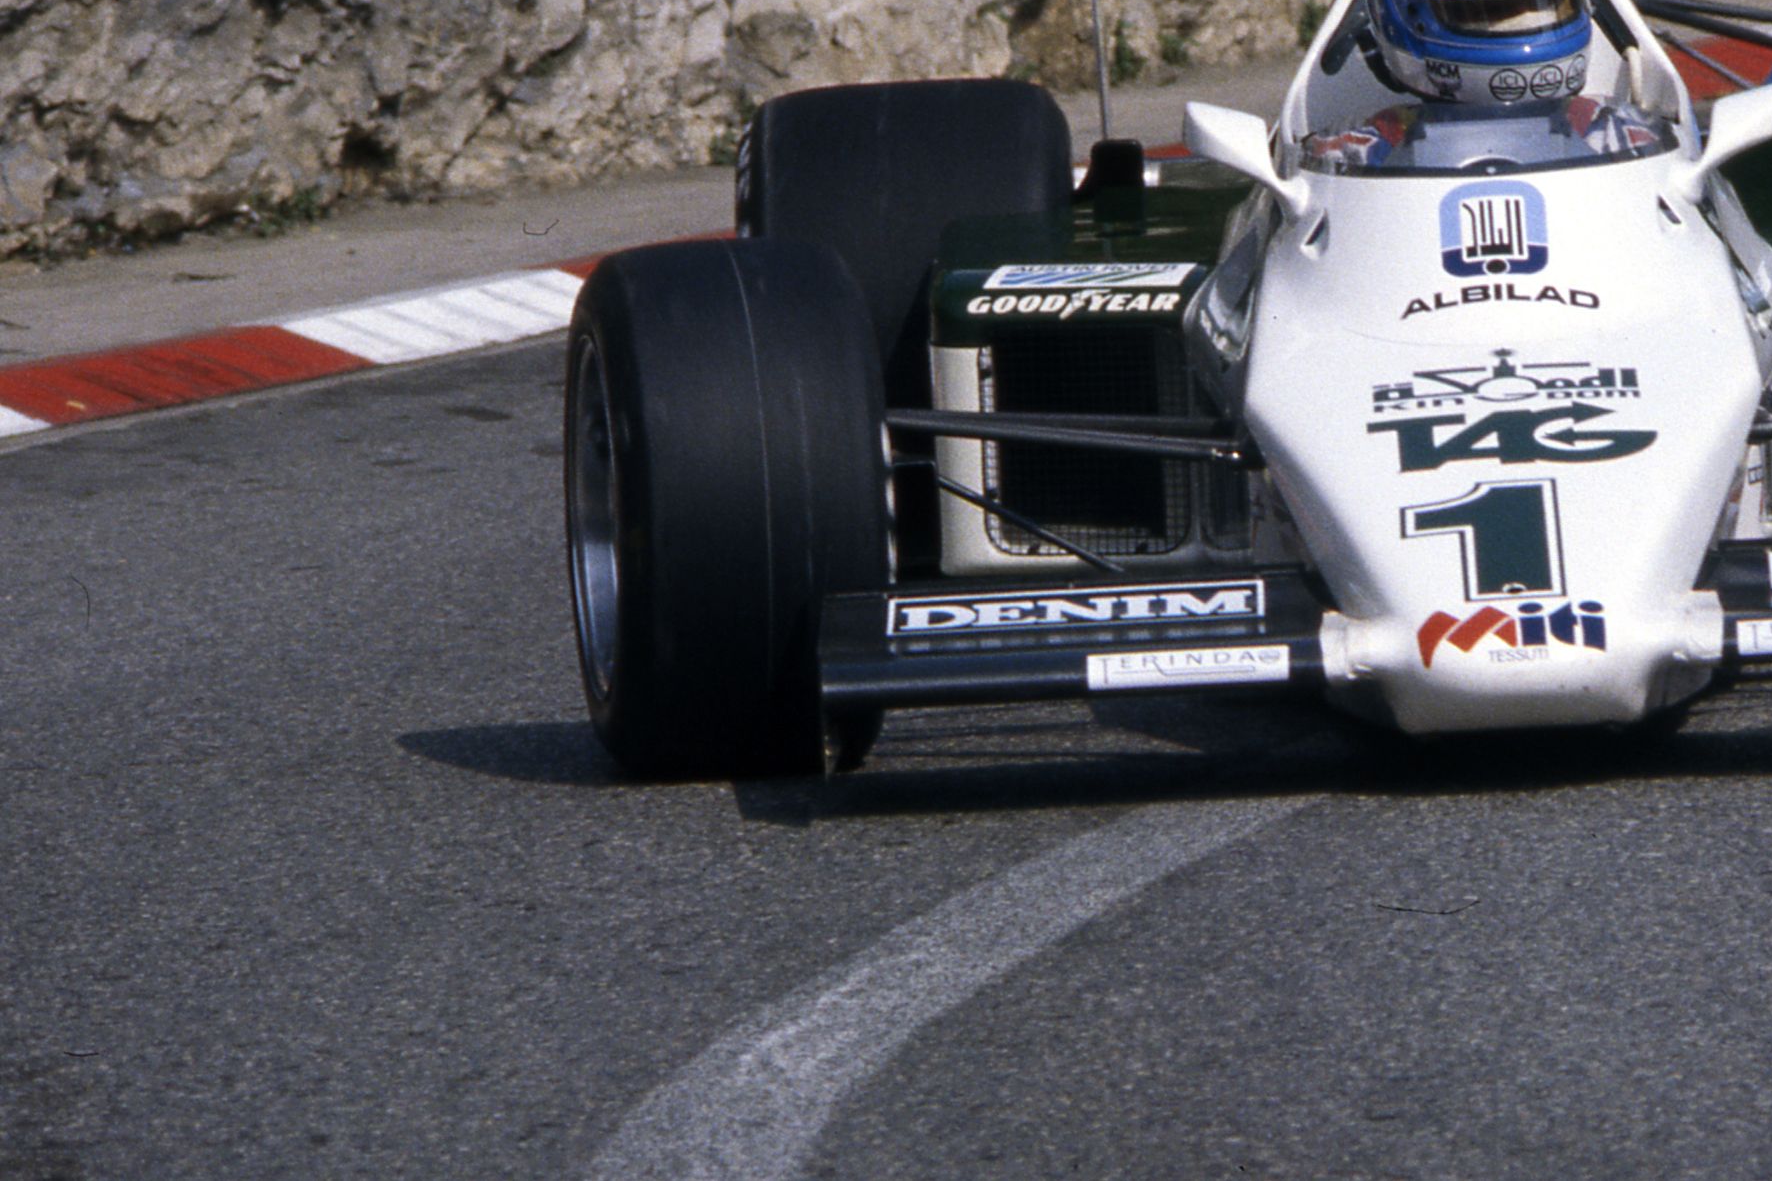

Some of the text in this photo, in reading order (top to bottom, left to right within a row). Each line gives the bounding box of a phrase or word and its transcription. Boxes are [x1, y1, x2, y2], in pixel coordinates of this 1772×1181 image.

[1401, 283, 1601, 320] ALBILAD
[1366, 400, 1658, 473] TAG
[1400, 478, 1567, 603] 1
[900, 589, 1253, 632] DENIM
[1101, 650, 1256, 685] TERINDA
